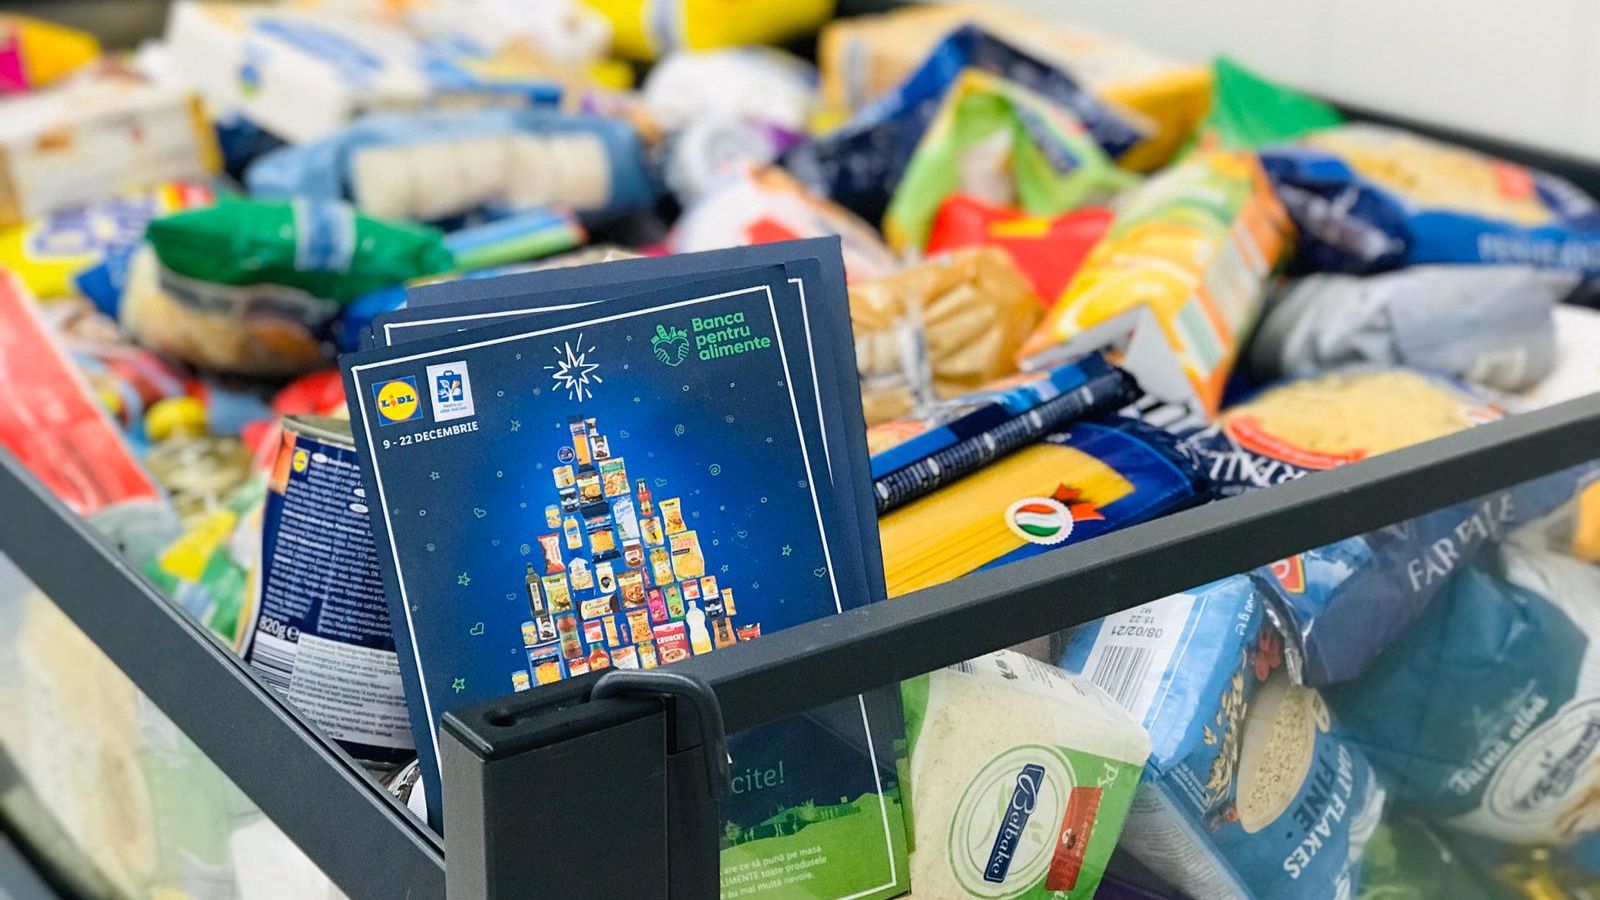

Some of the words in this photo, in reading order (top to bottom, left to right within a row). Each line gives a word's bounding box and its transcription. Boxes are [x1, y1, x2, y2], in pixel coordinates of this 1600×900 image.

[691, 311, 745, 332] Banca
[695, 326, 751, 349] pentru
[699, 336, 771, 360] alimente
[383, 440, 390, 449] 9
[400, 436, 412, 446] 22
[414, 421, 479, 443] DECEMBRIE
[258, 615, 287, 640] 820g
[656, 632, 685, 646] CRUNCHY
[1111, 626, 1163, 639] 08/02/21
[731, 760, 785, 794] cite!
[1295, 755, 1336, 832] FINE
[989, 773, 1039, 875] Belbake
[1283, 793, 1347, 879] FLAKES
[787, 851, 798, 861] pe
[720, 871, 761, 888] LIMENTE
[761, 867, 784, 880] toate
[785, 856, 827, 874] produsele
[740, 884, 756, 896] mai
